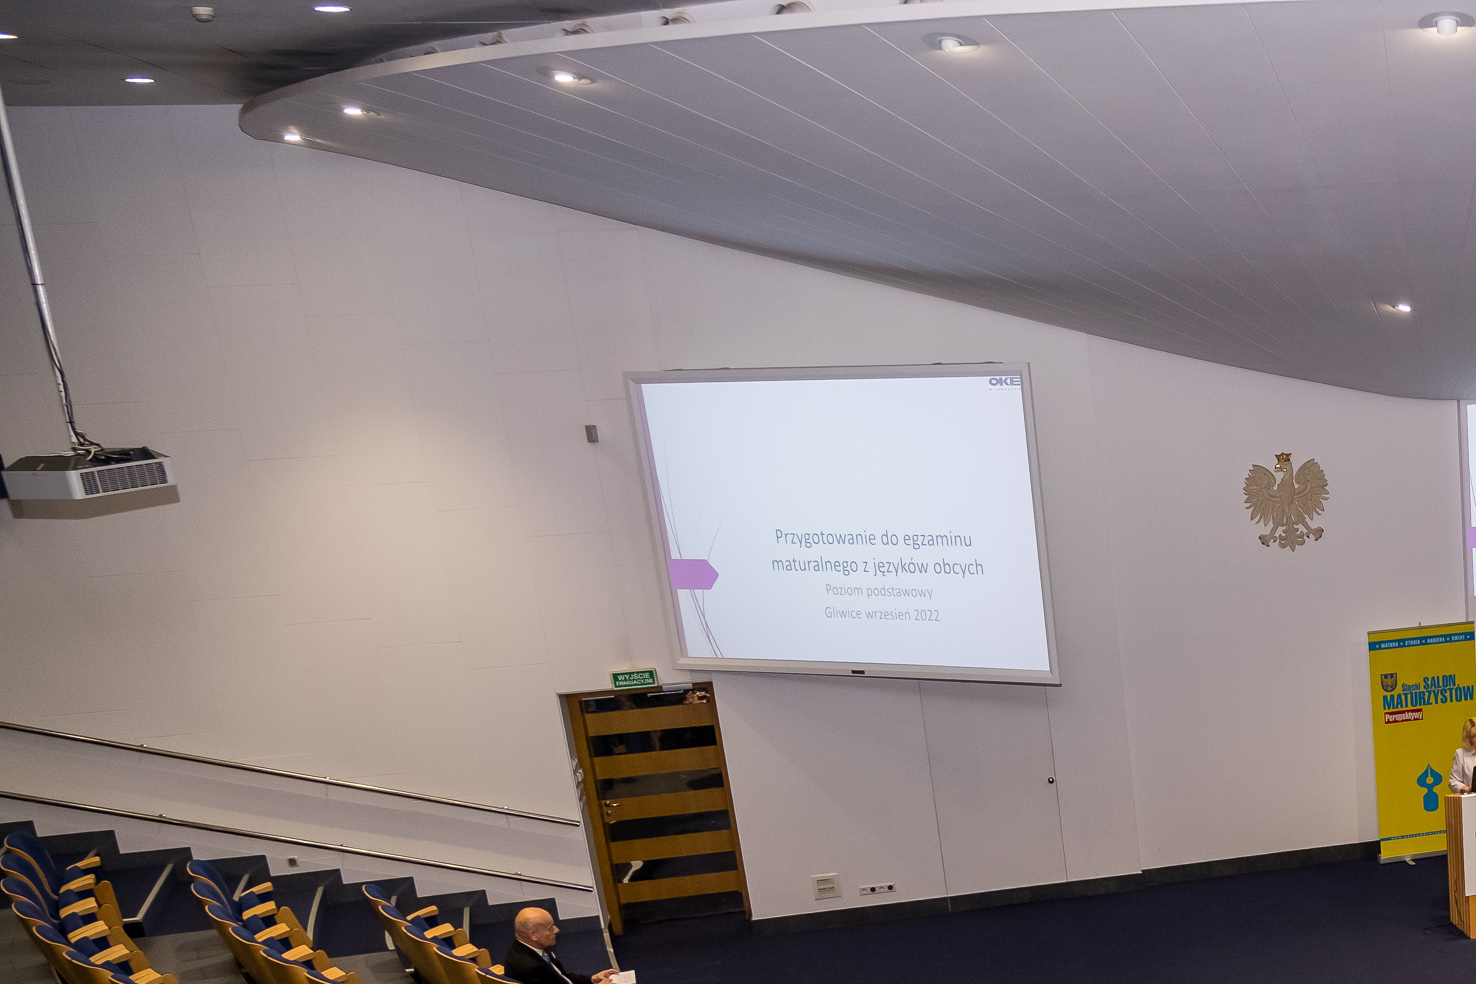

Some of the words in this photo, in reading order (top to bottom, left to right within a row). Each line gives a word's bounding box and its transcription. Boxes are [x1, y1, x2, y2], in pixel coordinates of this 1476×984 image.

[989, 377, 1020, 386] OKE
[775, 529, 876, 548] Przygotowanie
[881, 529, 899, 546] do
[903, 531, 973, 550] egzaminu
[771, 556, 858, 576] maturalnego
[863, 560, 870, 573] z
[872, 557, 929, 577] języków
[933, 558, 985, 578] obcych
[825, 583, 864, 597] Poziom
[866, 584, 933, 600] podstawowy
[824, 606, 863, 620] Gliwice
[864, 607, 911, 621] wrzesień
[914, 608, 941, 622] 2022
[617, 672, 650, 680] WYJŚCIE
[1402, 682, 1420, 692] Śląski
[1423, 674, 1456, 690] SALON
[1382, 684, 1474, 710] MATURZYSTÓW
[1385, 711, 1423, 722] Perspektywy
